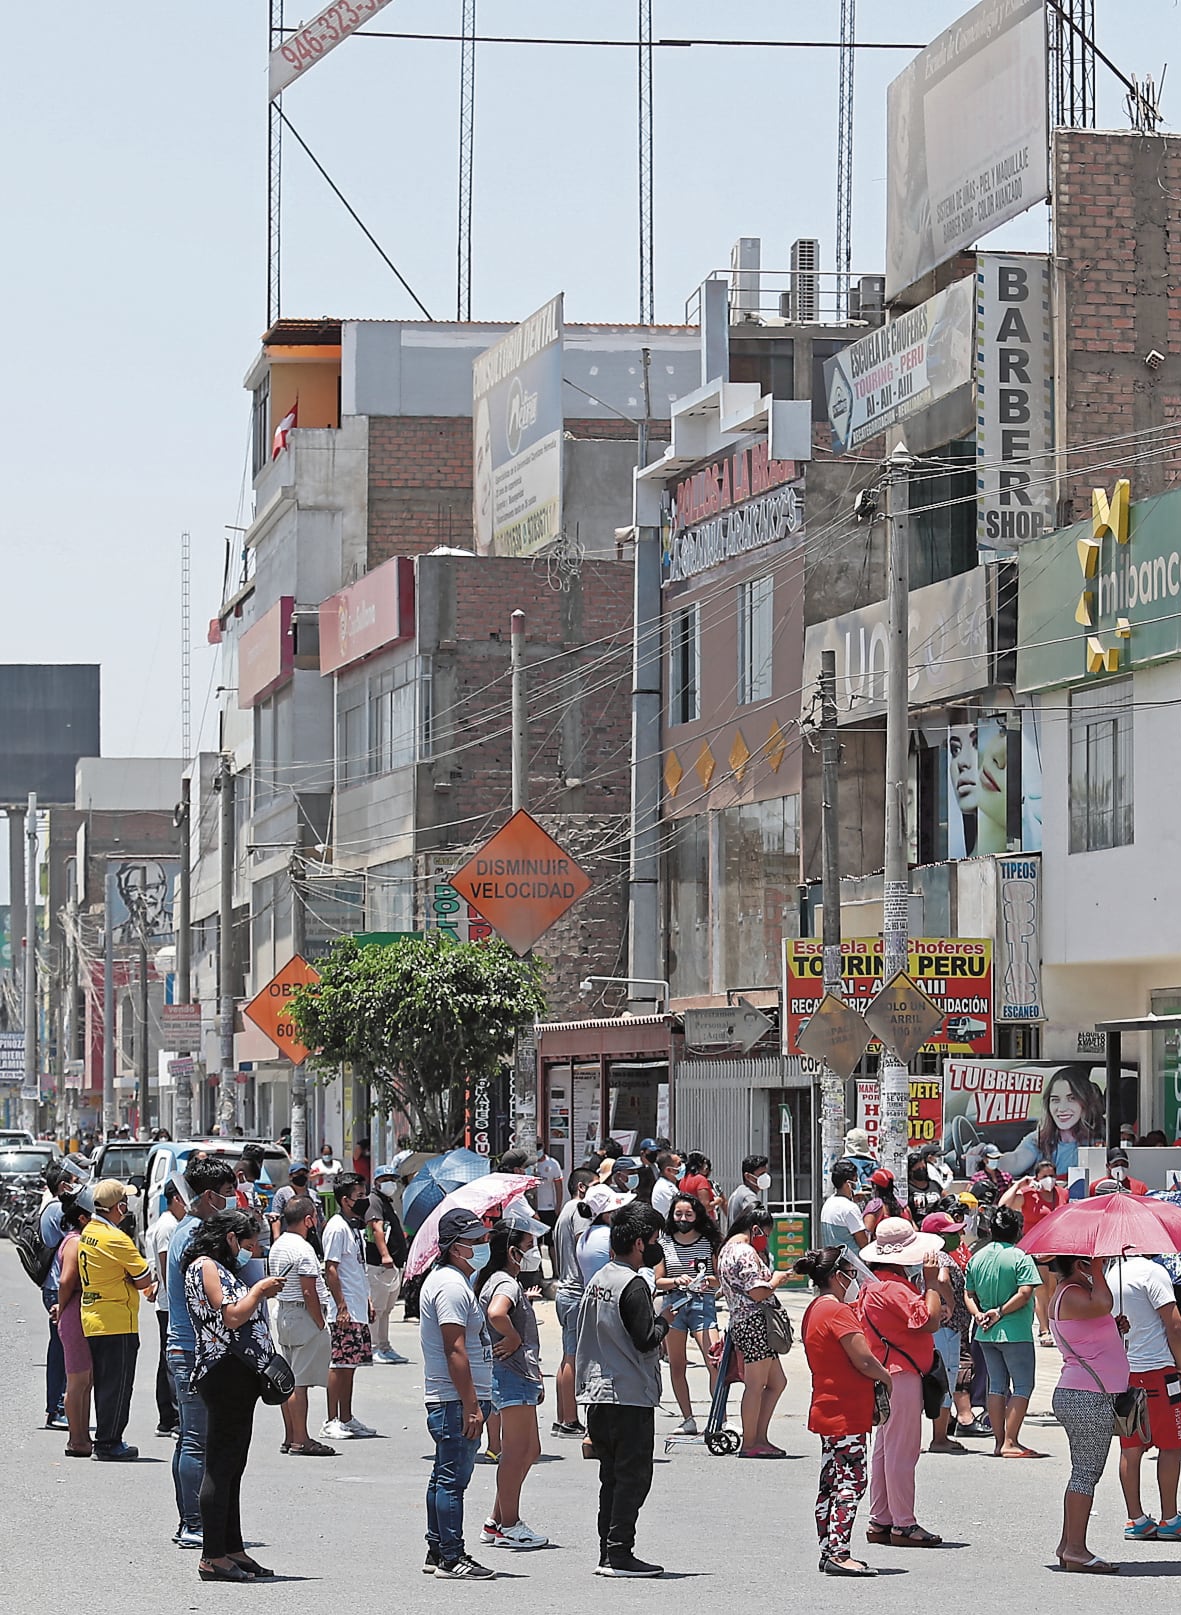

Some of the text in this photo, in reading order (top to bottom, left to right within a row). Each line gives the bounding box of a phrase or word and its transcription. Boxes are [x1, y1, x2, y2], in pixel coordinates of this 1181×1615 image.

[281, 0, 386, 70] 946-323-
[523, 300, 559, 362] DENTAL
[850, 306, 928, 378] ESCUELA DE CHOFERES
[853, 362, 894, 400] TOURING
[900, 344, 924, 373] PERU
[866, 395, 875, 418] AI
[880, 384, 892, 410] AII
[898, 373, 913, 399] AIII
[996, 266, 1033, 506] BARBER
[677, 463, 719, 527] POLLOS
[721, 458, 731, 510] A
[733, 449, 751, 503] LA
[986, 511, 1044, 539] SHOP
[476, 860, 569, 876] DISMINUIR
[1001, 862, 1036, 879] TIPEOS
[470, 882, 575, 898] VELOCIDAD
[793, 941, 870, 955] Escela
[908, 939, 984, 955] Choferes
[919, 956, 985, 976] PERU
[911, 1001, 926, 1010] UN
[932, 995, 988, 1014] ALIDACIÓN
[1003, 1005, 1039, 1018] ESCANEO
[801, 1060, 821, 1072] COP
[951, 1065, 1043, 1093] TU BREVETE
[909, 1082, 938, 1099] VETE
[976, 1093, 1031, 1124] YA!!!
[908, 1121, 935, 1140] OTO
